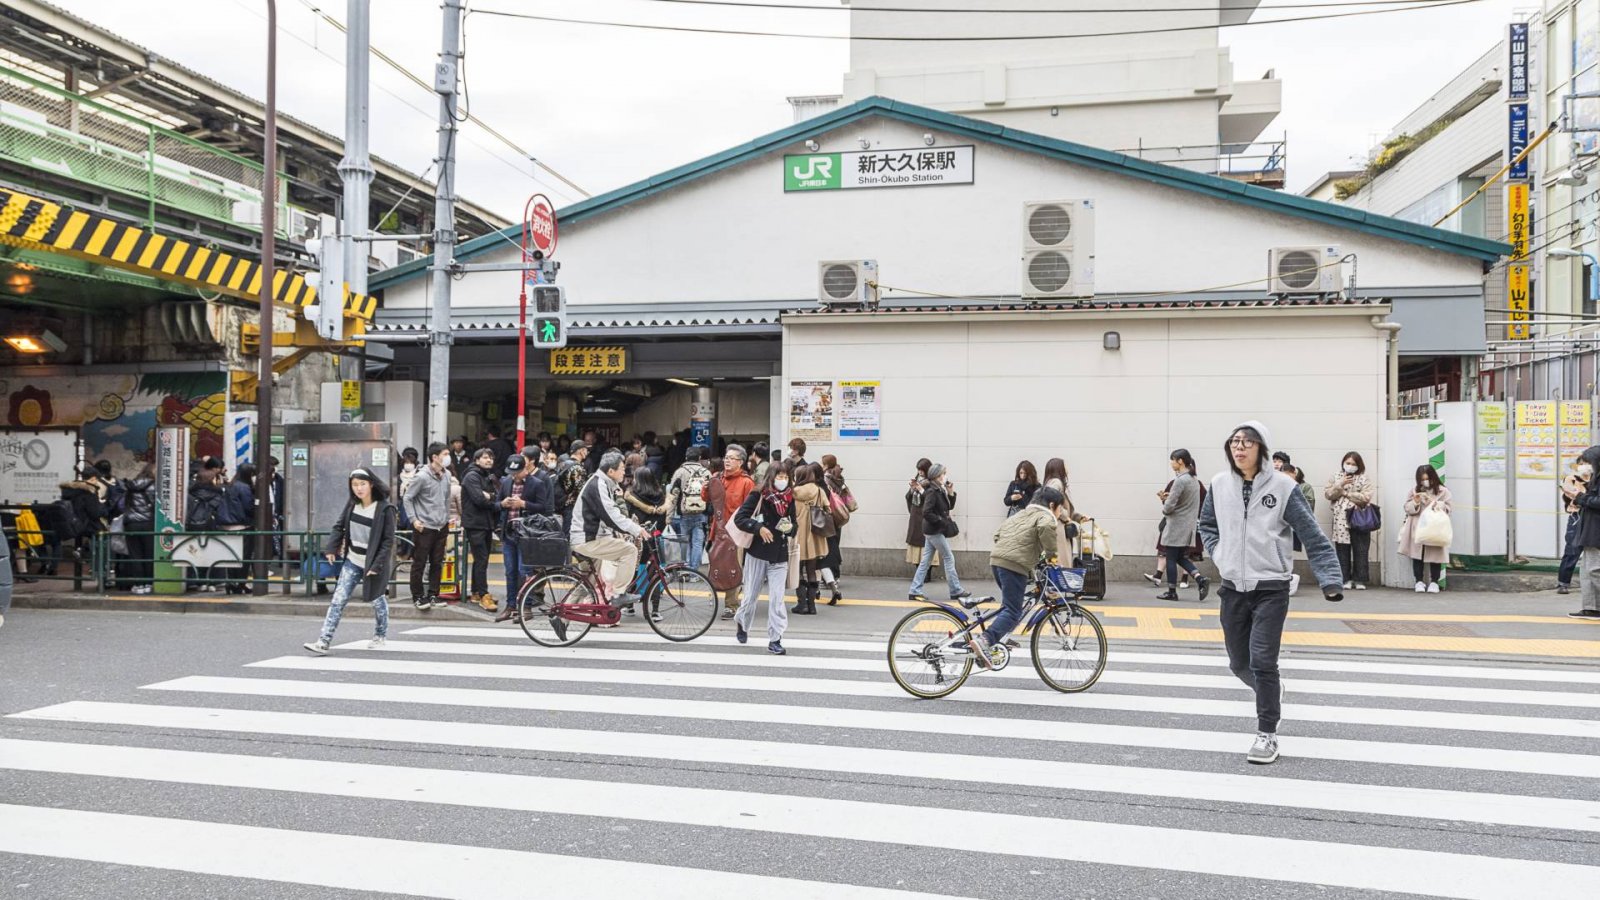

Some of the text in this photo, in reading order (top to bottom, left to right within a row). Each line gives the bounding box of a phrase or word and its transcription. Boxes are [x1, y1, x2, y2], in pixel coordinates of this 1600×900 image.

[1512, 42, 1525, 92] 山野楽器
[1512, 120, 1526, 143] Wind
[794, 156, 832, 180] JR
[858, 151, 955, 174] 新大久保駅
[912, 173, 944, 182] Station
[532, 213, 552, 240] 消火栓
[1512, 212, 1525, 259] 幻の手羽先
[555, 353, 621, 368] 段差注意
